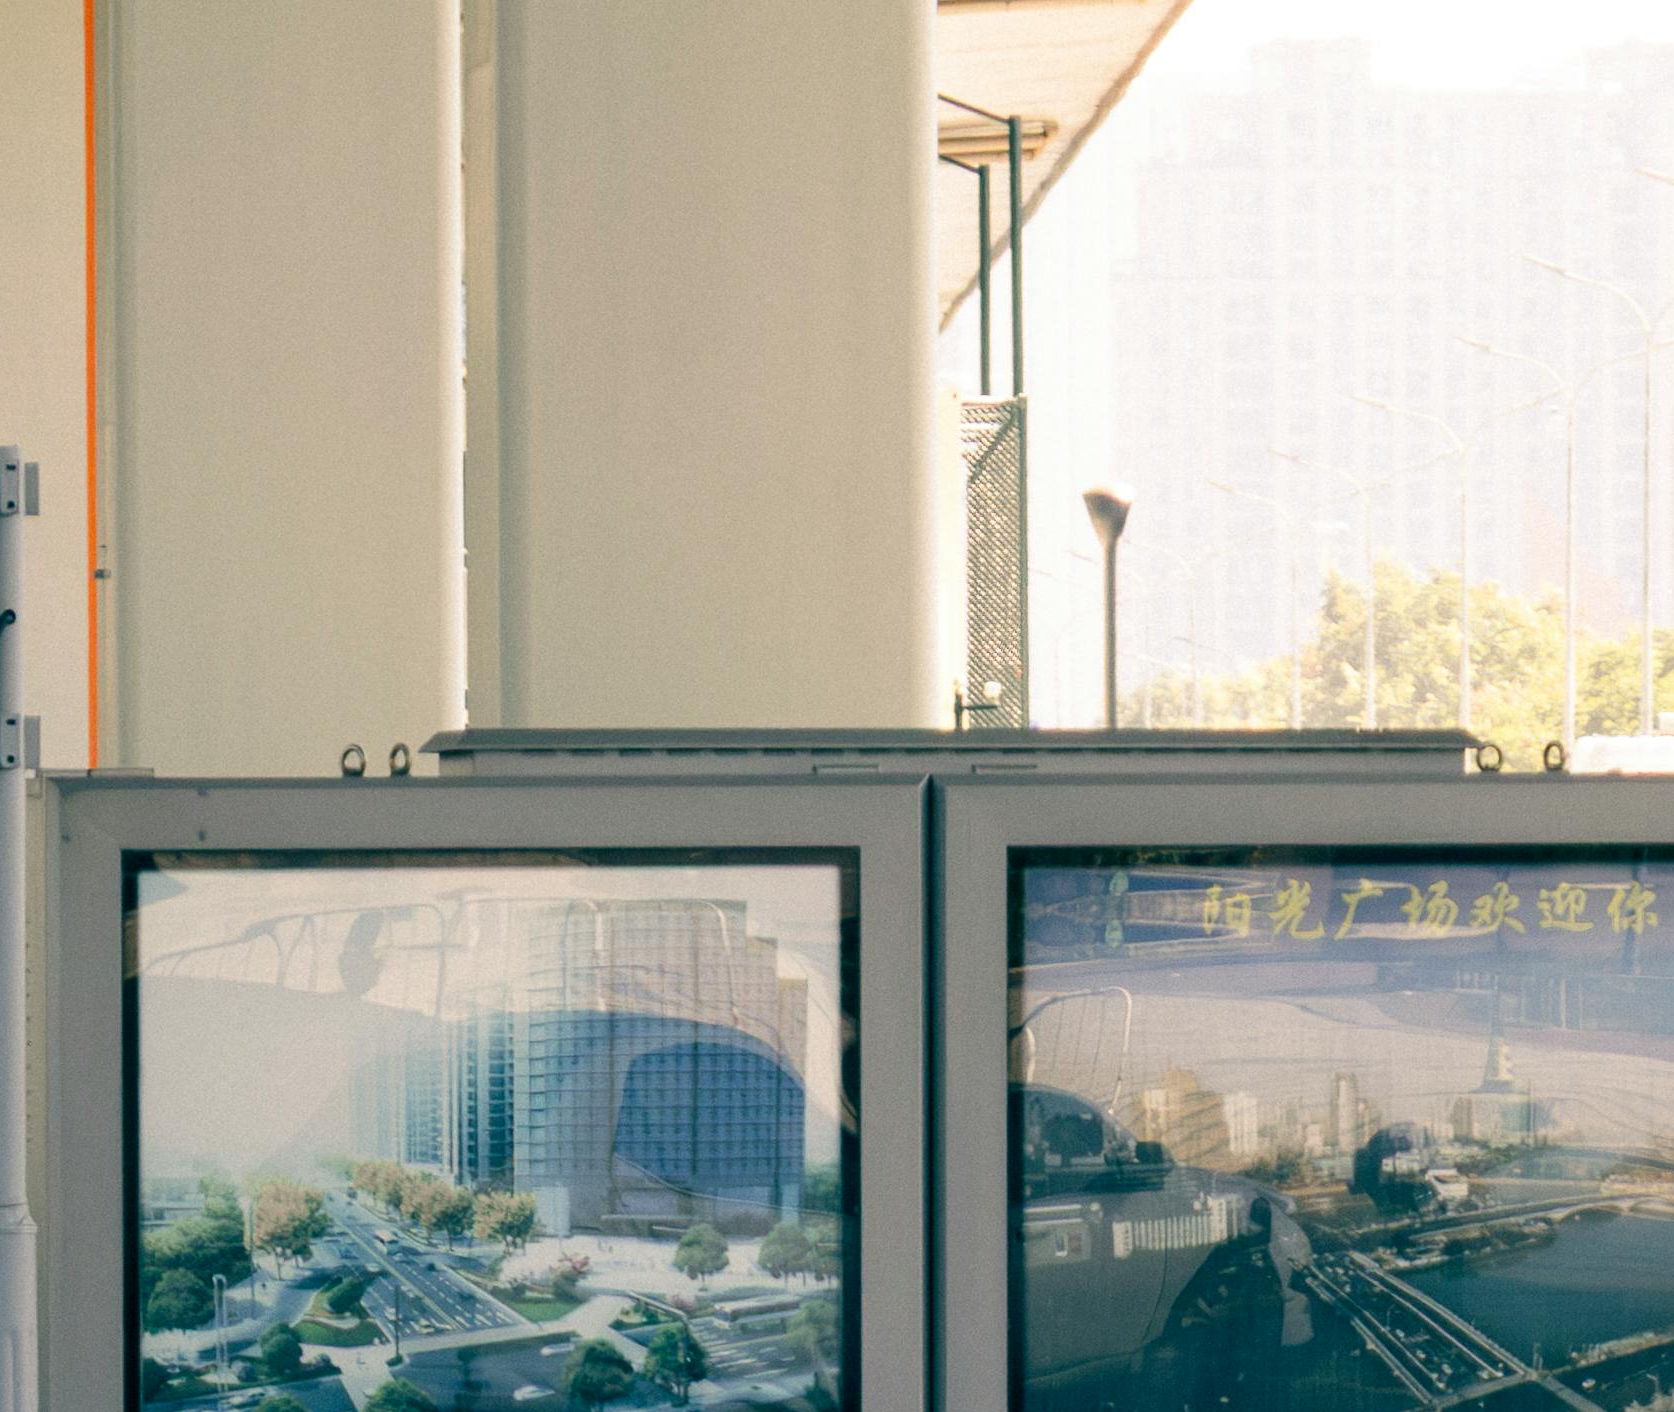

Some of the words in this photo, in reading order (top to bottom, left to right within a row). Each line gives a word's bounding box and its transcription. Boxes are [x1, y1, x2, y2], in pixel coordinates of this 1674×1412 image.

[1200, 877, 1658, 940] 阳光广场欢迎你
